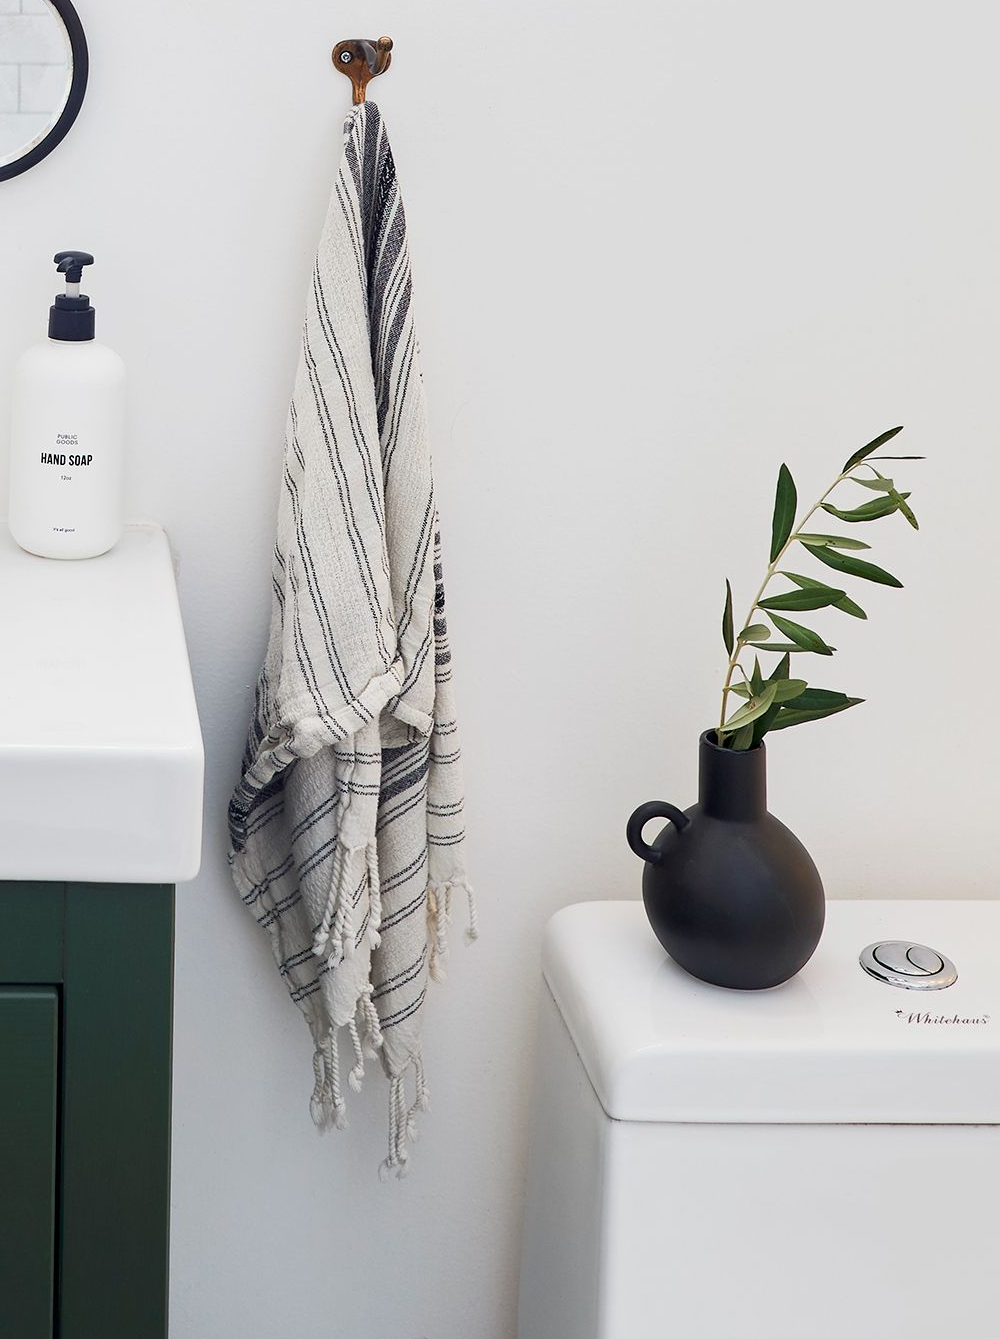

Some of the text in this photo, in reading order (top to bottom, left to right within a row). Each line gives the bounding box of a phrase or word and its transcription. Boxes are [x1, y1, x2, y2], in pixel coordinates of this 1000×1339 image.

[41, 452, 93, 466] HAND SOAP
[904, 1012, 988, 1025] Whitehaus
